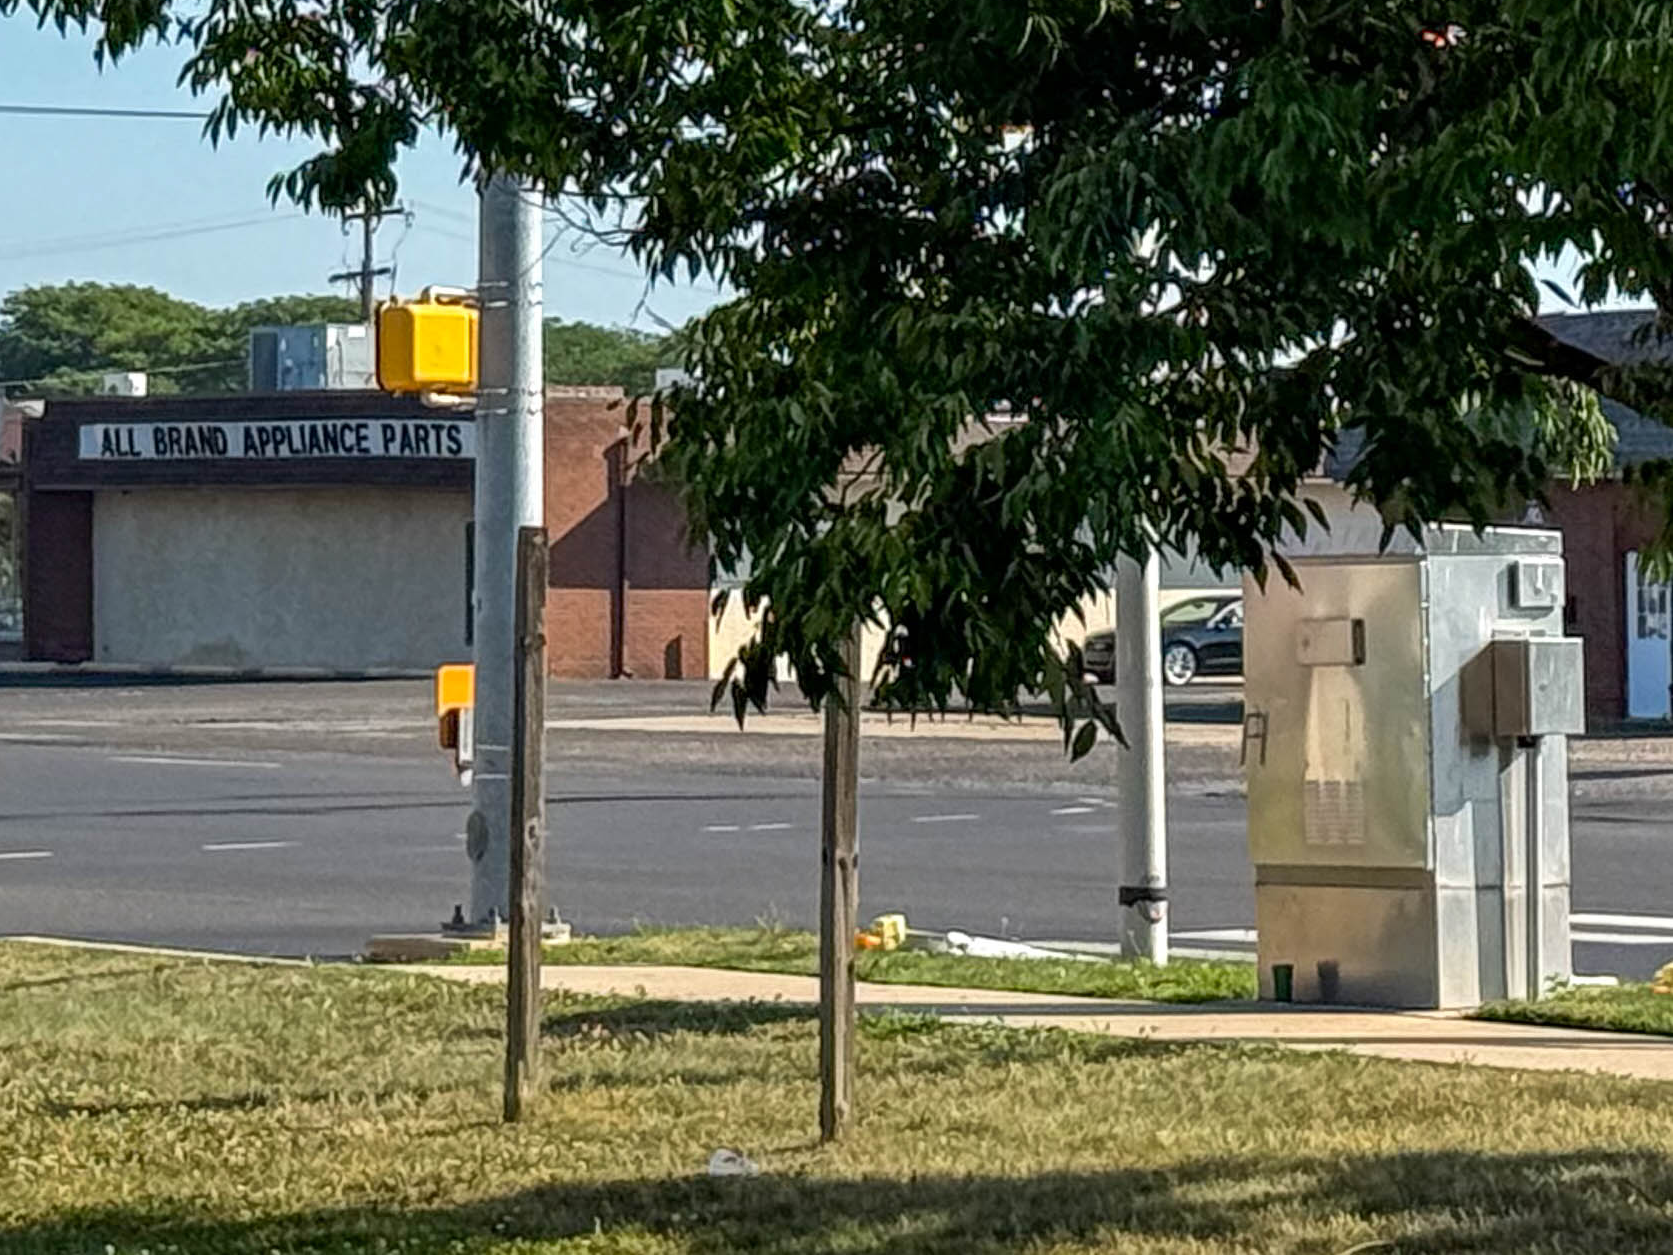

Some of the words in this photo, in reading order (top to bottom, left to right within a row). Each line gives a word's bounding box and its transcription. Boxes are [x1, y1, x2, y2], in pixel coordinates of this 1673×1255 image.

[101, 426, 142, 457] ALL
[153, 425, 228, 457] BRAND
[242, 423, 370, 456] APPLIANCE
[382, 423, 462, 455] PARTS
